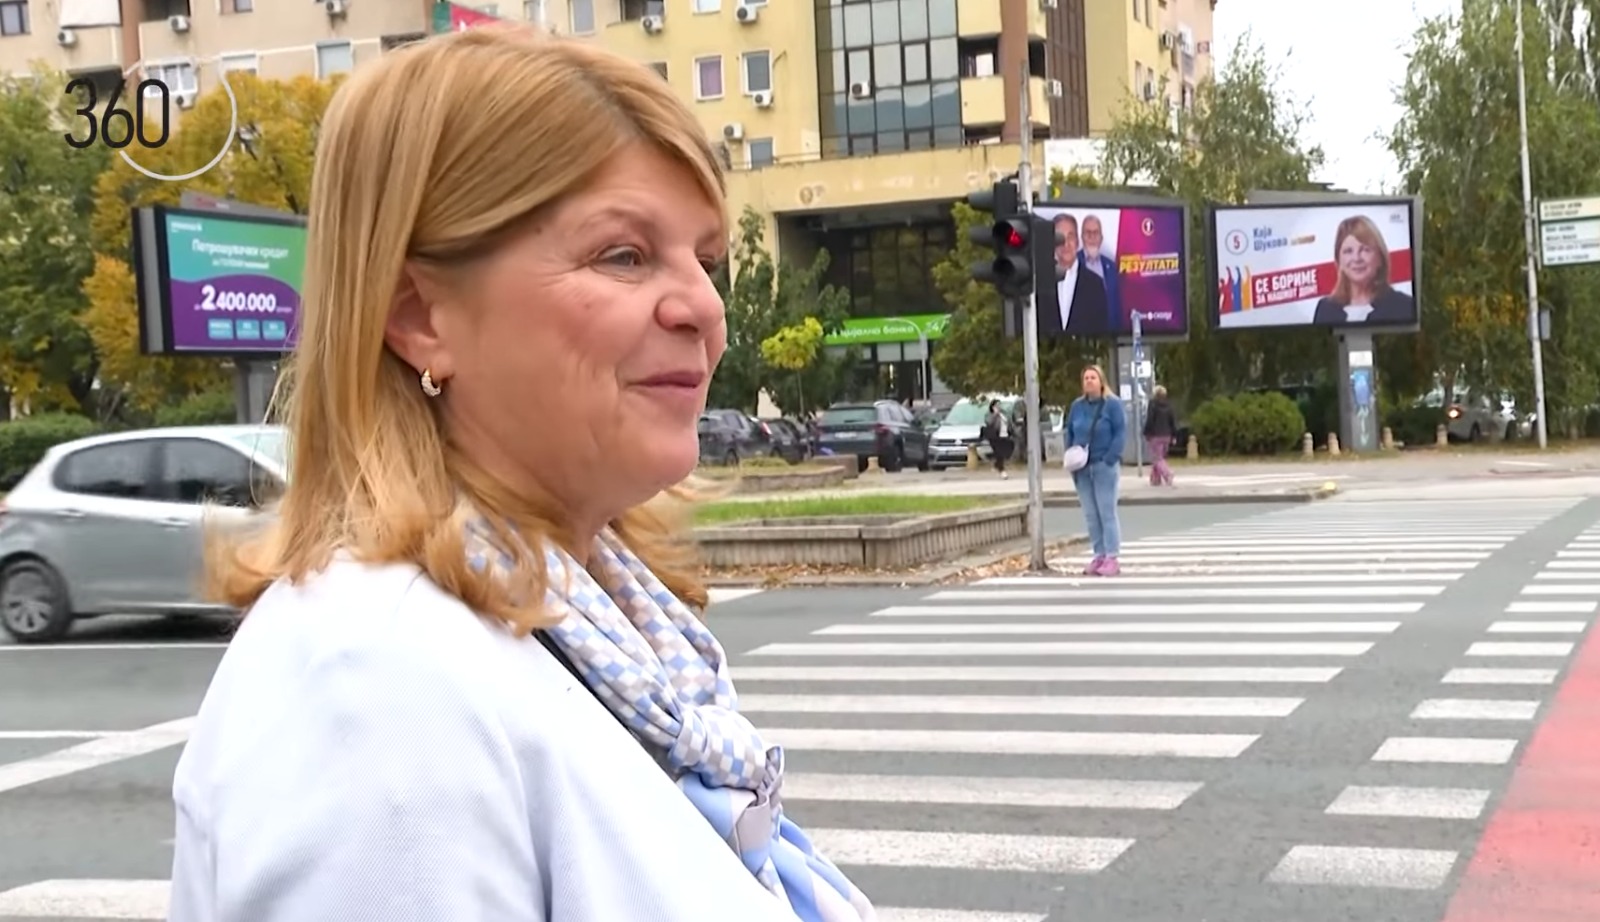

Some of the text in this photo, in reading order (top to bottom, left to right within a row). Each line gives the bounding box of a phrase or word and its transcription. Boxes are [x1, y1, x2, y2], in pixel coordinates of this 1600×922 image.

[1233, 233, 1241, 250] 5
[1120, 258, 1179, 273] РЕЗУЛТАТИ
[1255, 269, 1318, 293] СЕ БОРИМЕ
